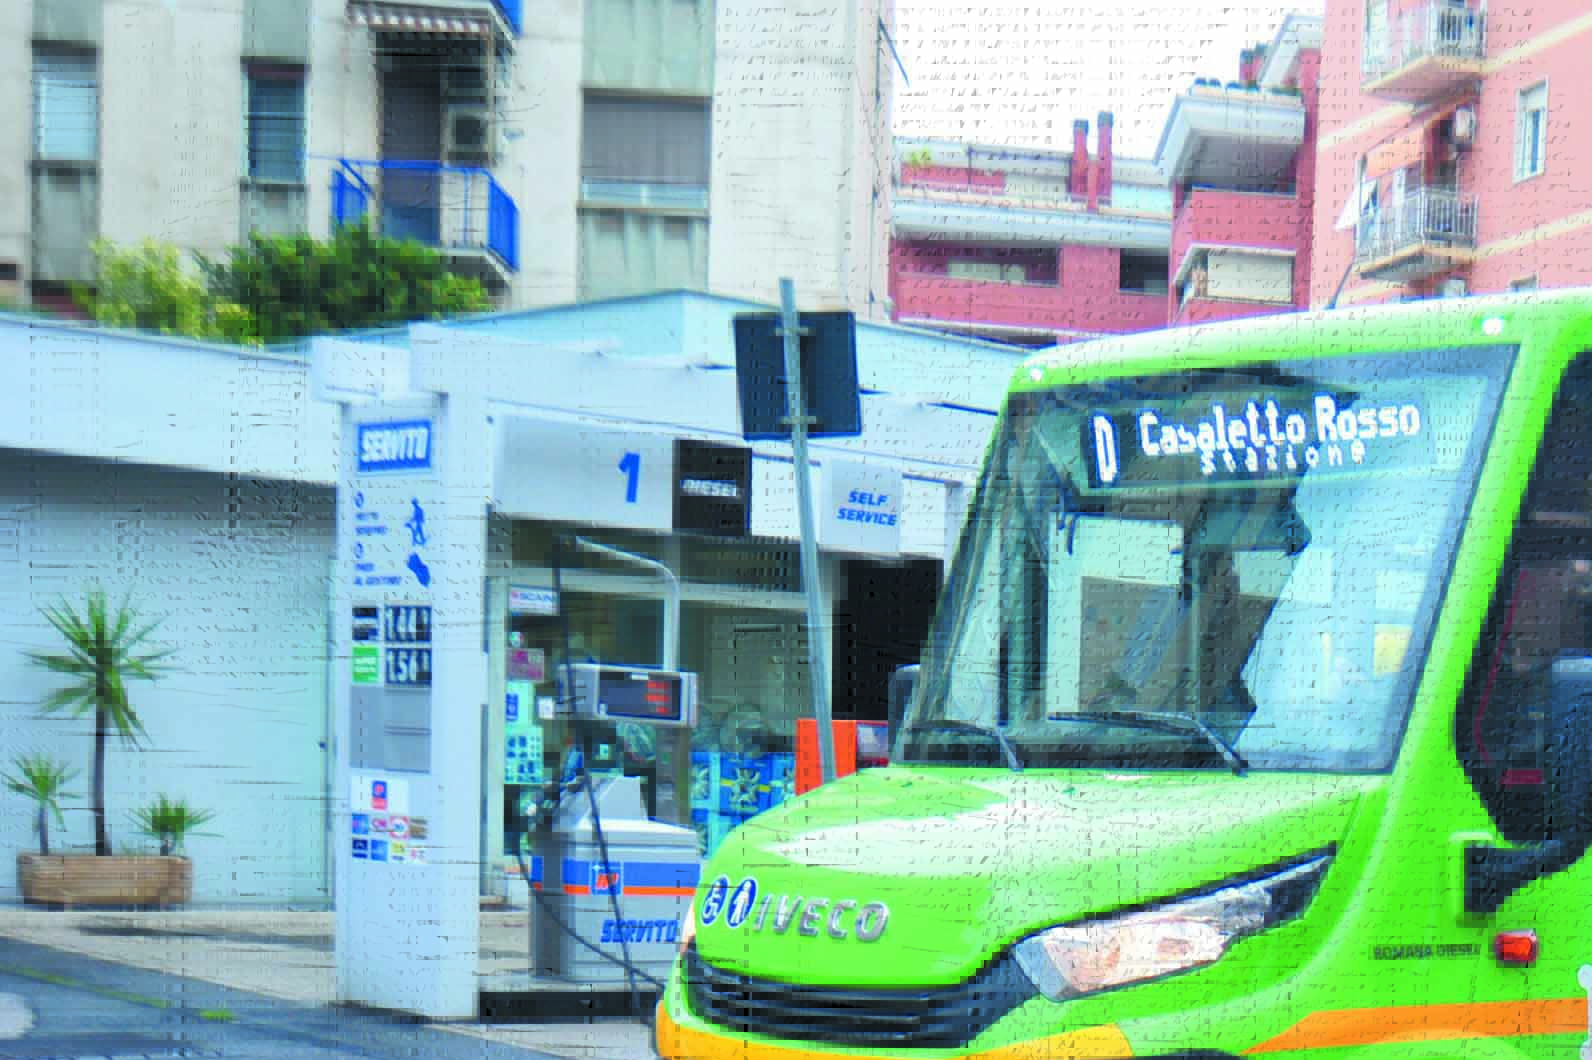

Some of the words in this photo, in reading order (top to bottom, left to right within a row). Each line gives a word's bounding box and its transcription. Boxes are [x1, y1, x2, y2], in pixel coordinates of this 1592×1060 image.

[361, 427, 429, 462] SERVITO
[1093, 415, 1118, 482] D
[1140, 405, 1306, 456] Casaletto
[1314, 396, 1420, 442] Rosso
[617, 452, 641, 503] 1
[848, 491, 888, 506] SELF
[837, 507, 897, 527] SERVICE
[601, 919, 678, 943] SERVITO
[754, 894, 889, 942] IVECO
